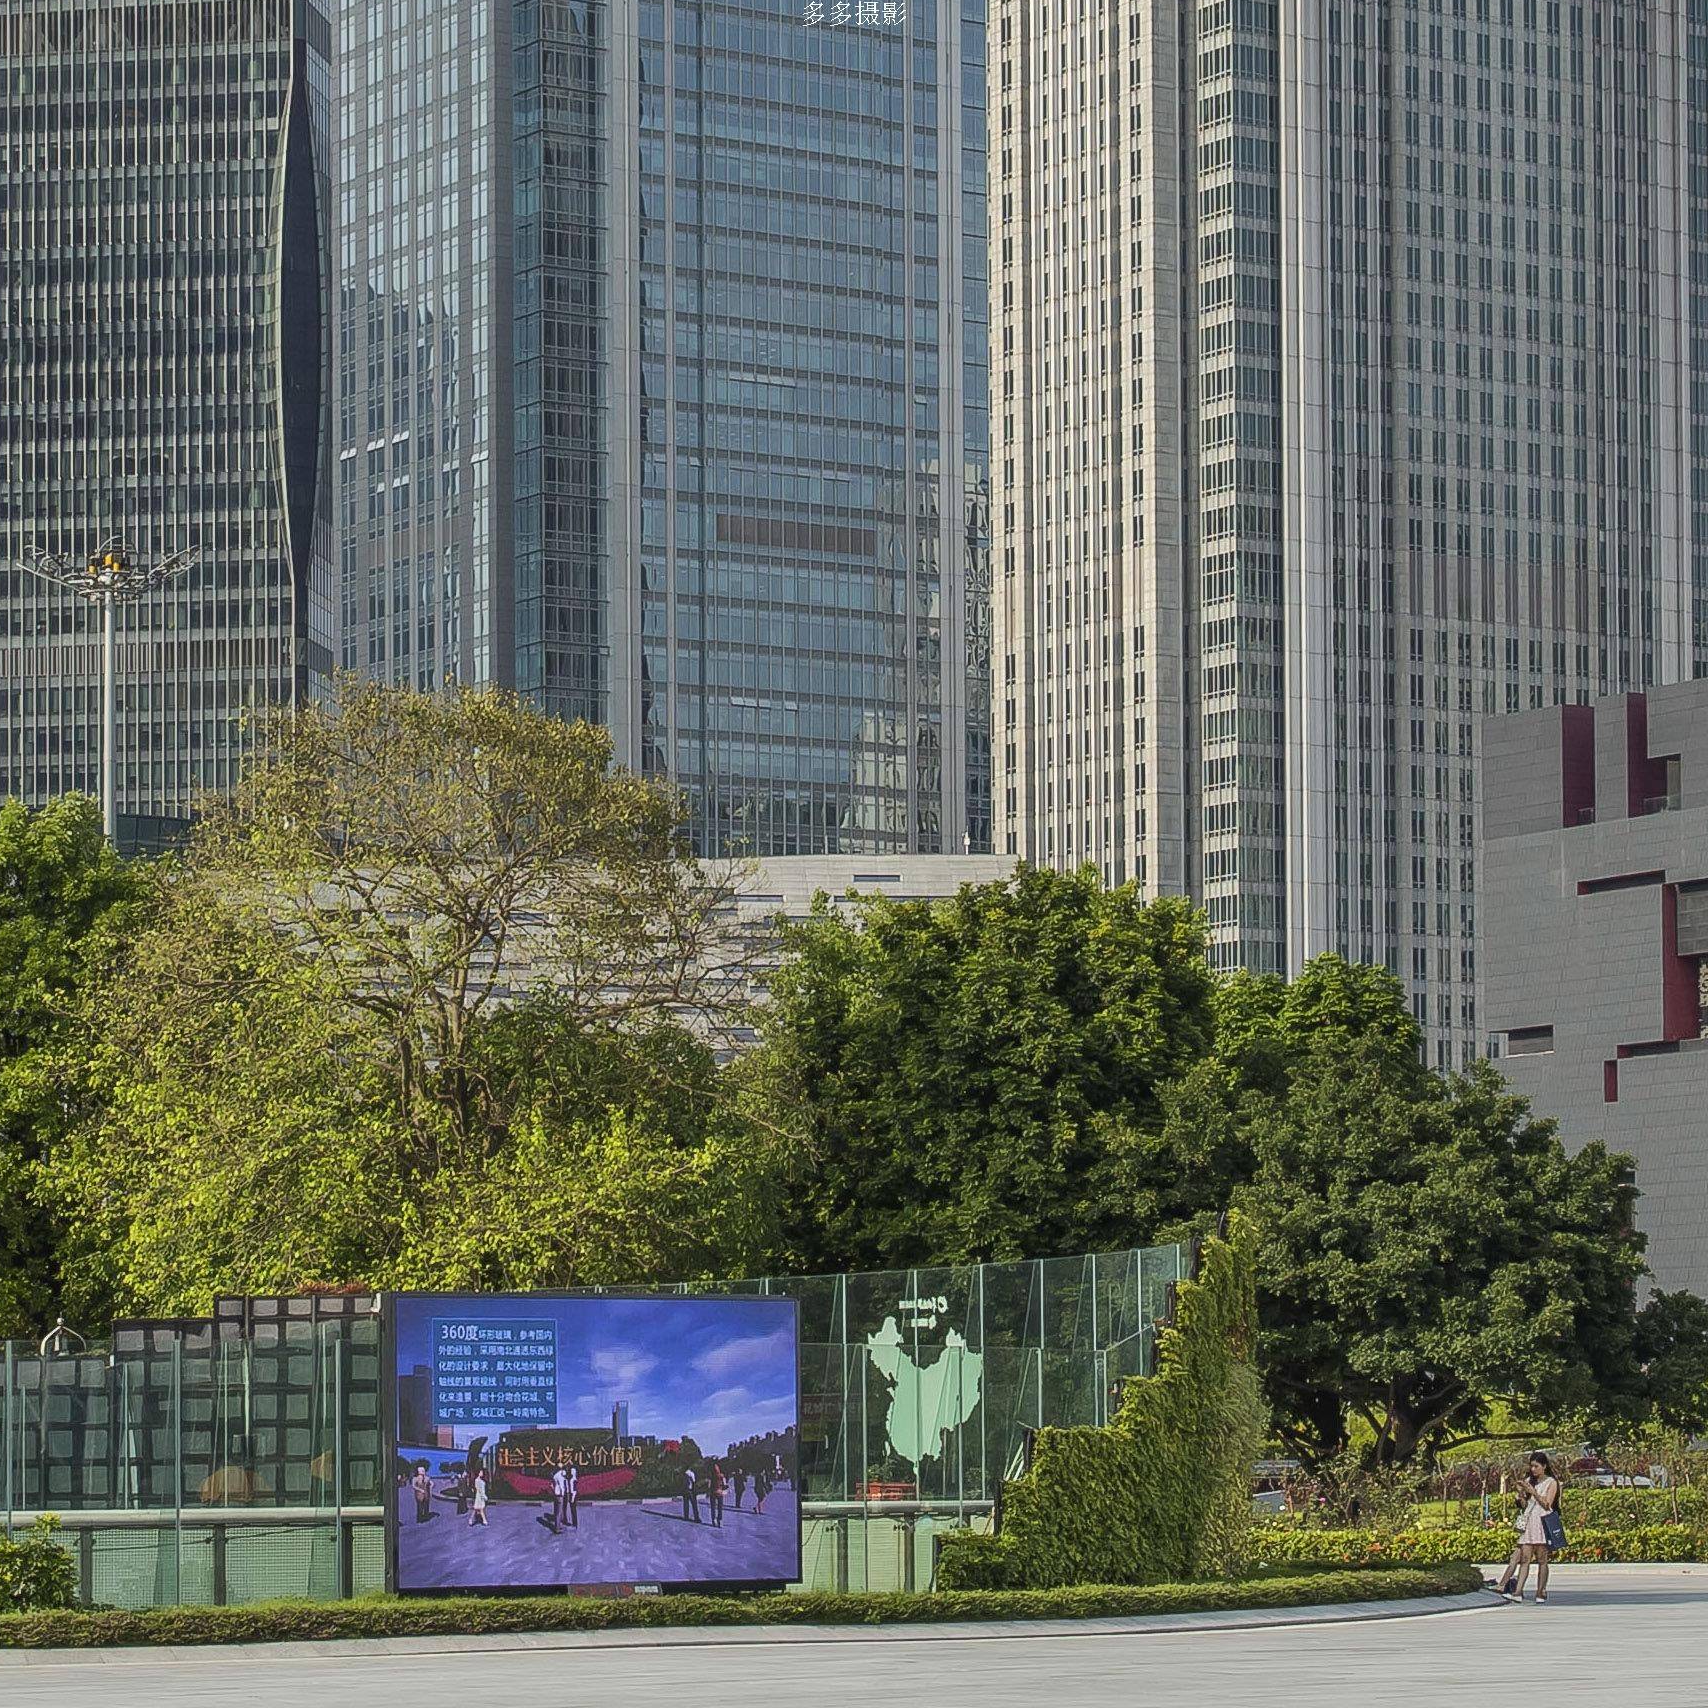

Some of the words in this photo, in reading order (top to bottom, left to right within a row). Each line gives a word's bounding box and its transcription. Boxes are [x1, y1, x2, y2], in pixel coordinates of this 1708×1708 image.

[498, 1445, 642, 1467] 社会主义核心价值观
